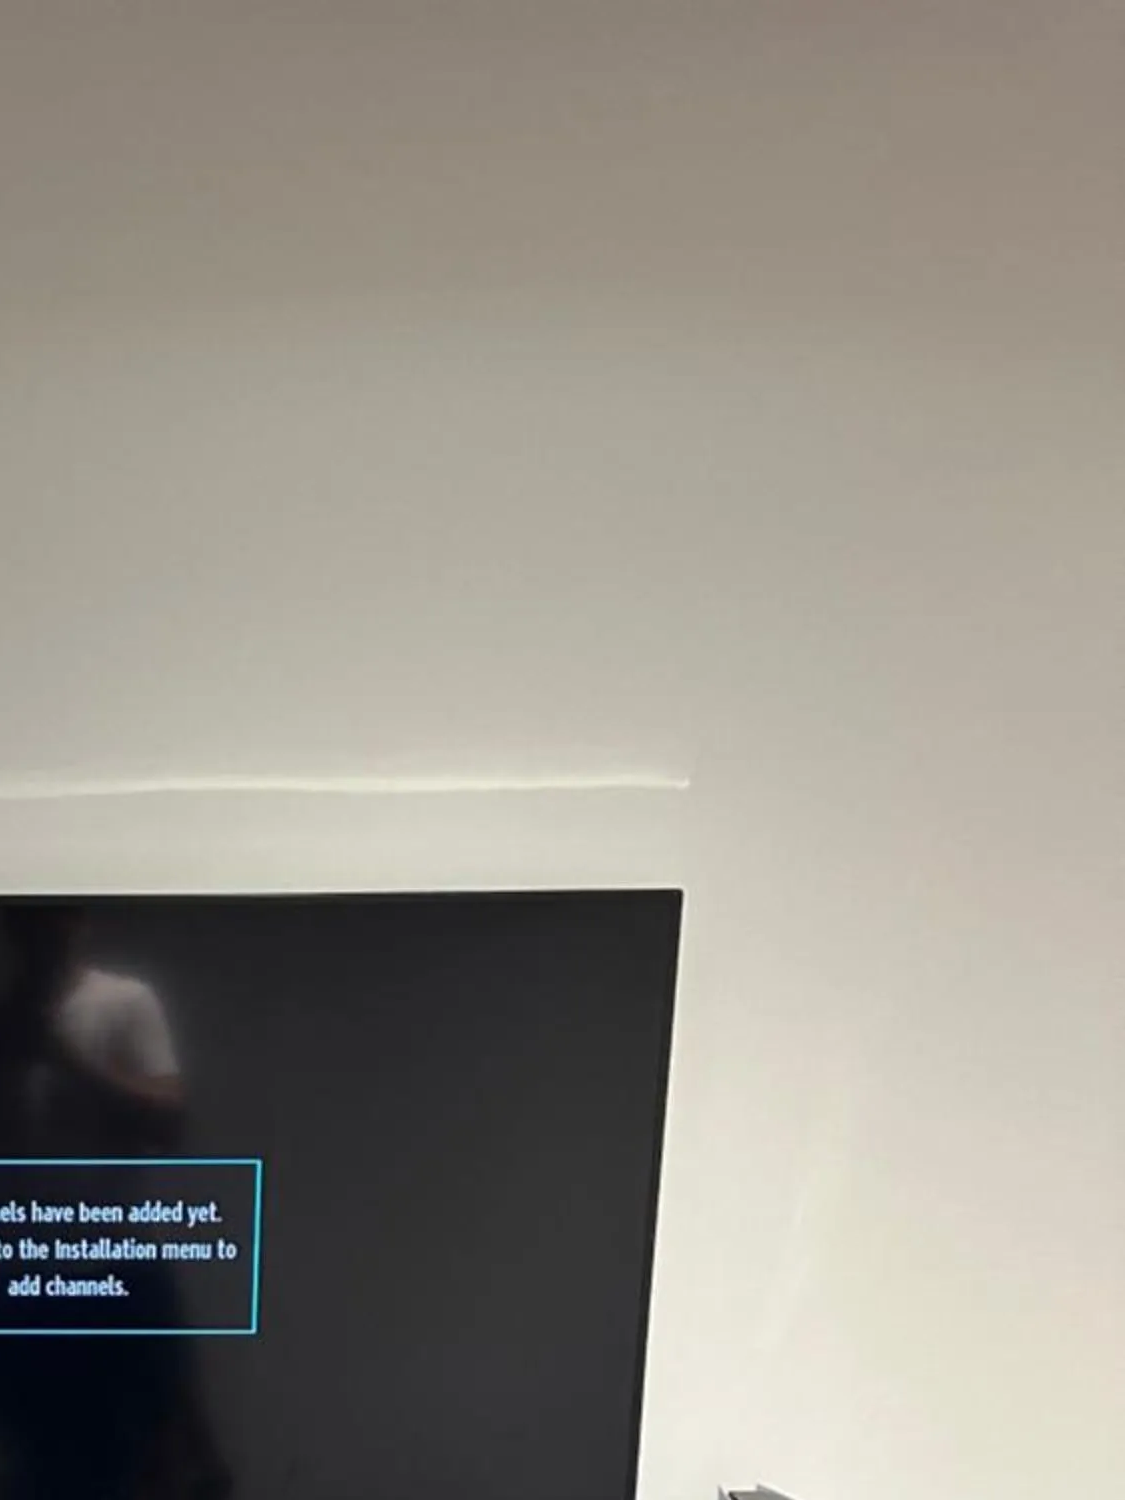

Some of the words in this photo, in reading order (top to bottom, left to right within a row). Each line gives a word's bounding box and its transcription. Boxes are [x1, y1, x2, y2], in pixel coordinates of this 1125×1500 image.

[31, 1201, 73, 1222] have
[79, 1201, 122, 1222] been
[128, 1201, 182, 1222] added
[187, 1204, 222, 1227] yet.
[19, 1239, 49, 1260] the
[55, 1239, 156, 1260] Installation
[162, 1243, 212, 1260] menu
[218, 1240, 236, 1260] to
[8, 1275, 40, 1296] add
[46, 1275, 129, 1296] channels.
